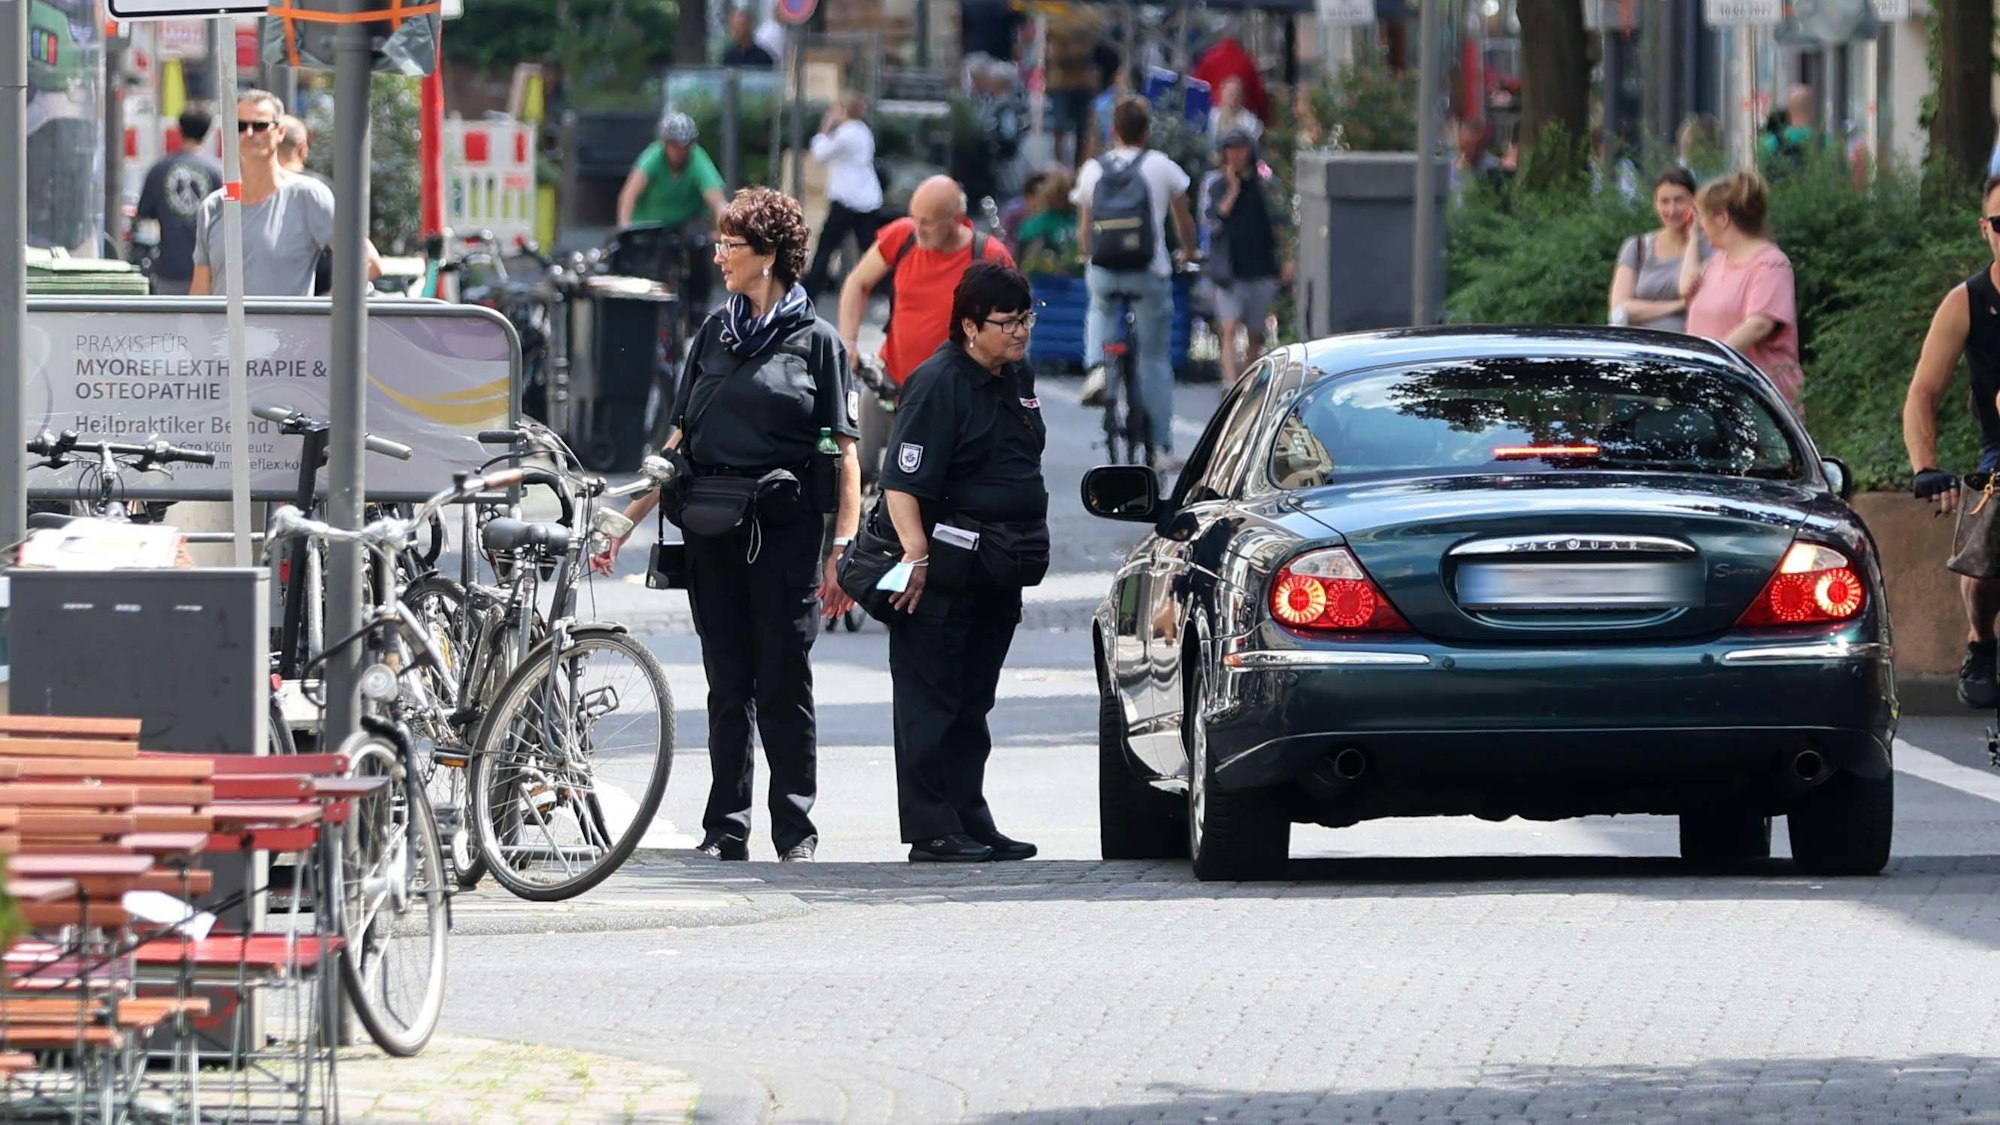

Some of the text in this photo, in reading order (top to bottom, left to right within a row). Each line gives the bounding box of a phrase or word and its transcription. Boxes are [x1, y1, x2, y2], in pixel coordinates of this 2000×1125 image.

[76, 333, 188, 352] PRAXIS FÜR
[76, 359, 328, 377] MYOREFLEXTHRAPIE &
[75, 382, 221, 399] OSTEOPATHIE
[75, 415, 206, 437] Heilpraktiker
[211, 416, 269, 434] Bend
